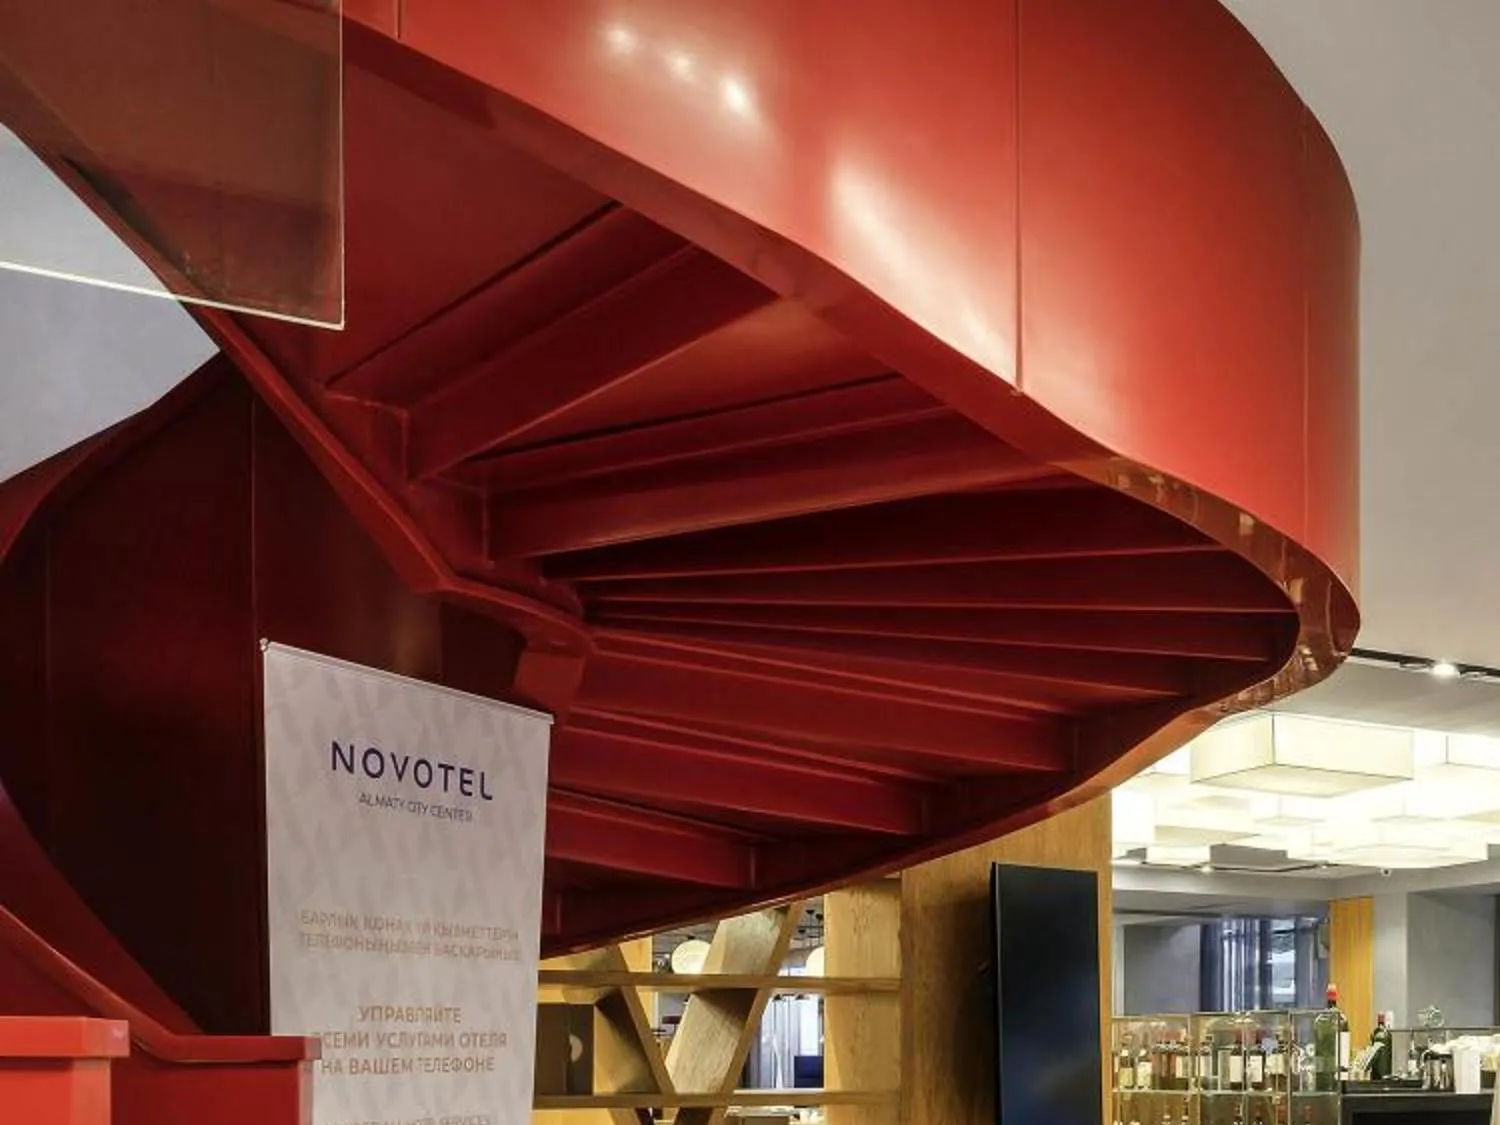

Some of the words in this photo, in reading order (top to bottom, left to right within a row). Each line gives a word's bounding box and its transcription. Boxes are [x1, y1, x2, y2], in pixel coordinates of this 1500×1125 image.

[331, 740, 493, 801] NOVOTEL
[359, 792, 405, 808] ALMATY
[407, 800, 429, 816] CITY
[430, 805, 473, 822] CENTER
[358, 1003, 462, 1024] УПРАВЛЯЙТЕ
[312, 1031, 370, 1049] СЕМИ
[375, 1031, 455, 1049] УСЛУГАМИ
[459, 1031, 508, 1049] ОТЕЛЯ
[321, 1058, 344, 1075] НА
[349, 1057, 414, 1075] ВАШЕМ
[418, 1055, 496, 1074] ТЕЛЕФОНЕ
